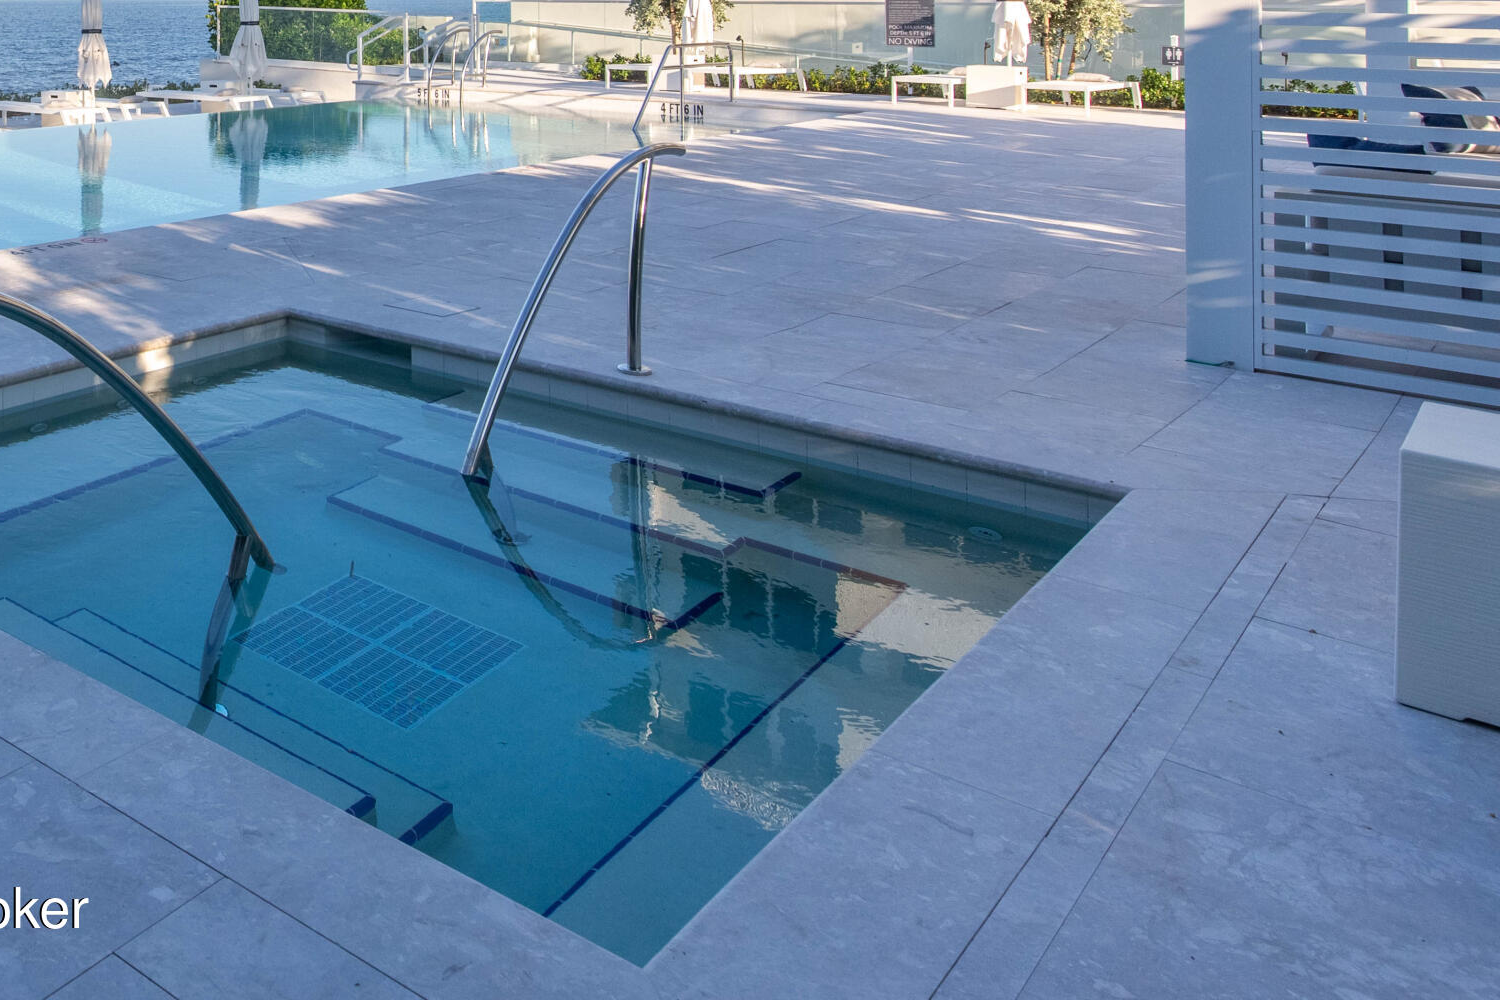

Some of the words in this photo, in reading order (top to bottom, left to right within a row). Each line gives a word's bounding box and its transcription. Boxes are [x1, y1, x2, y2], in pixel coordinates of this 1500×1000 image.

[905, 38, 933, 46] DIVING
[418, 89, 422, 97] 5
[442, 90, 450, 99] IN
[661, 103, 666, 113] 4
[671, 104, 681, 114] FT
[685, 105, 690, 115] 6
[694, 105, 704, 116] IN
